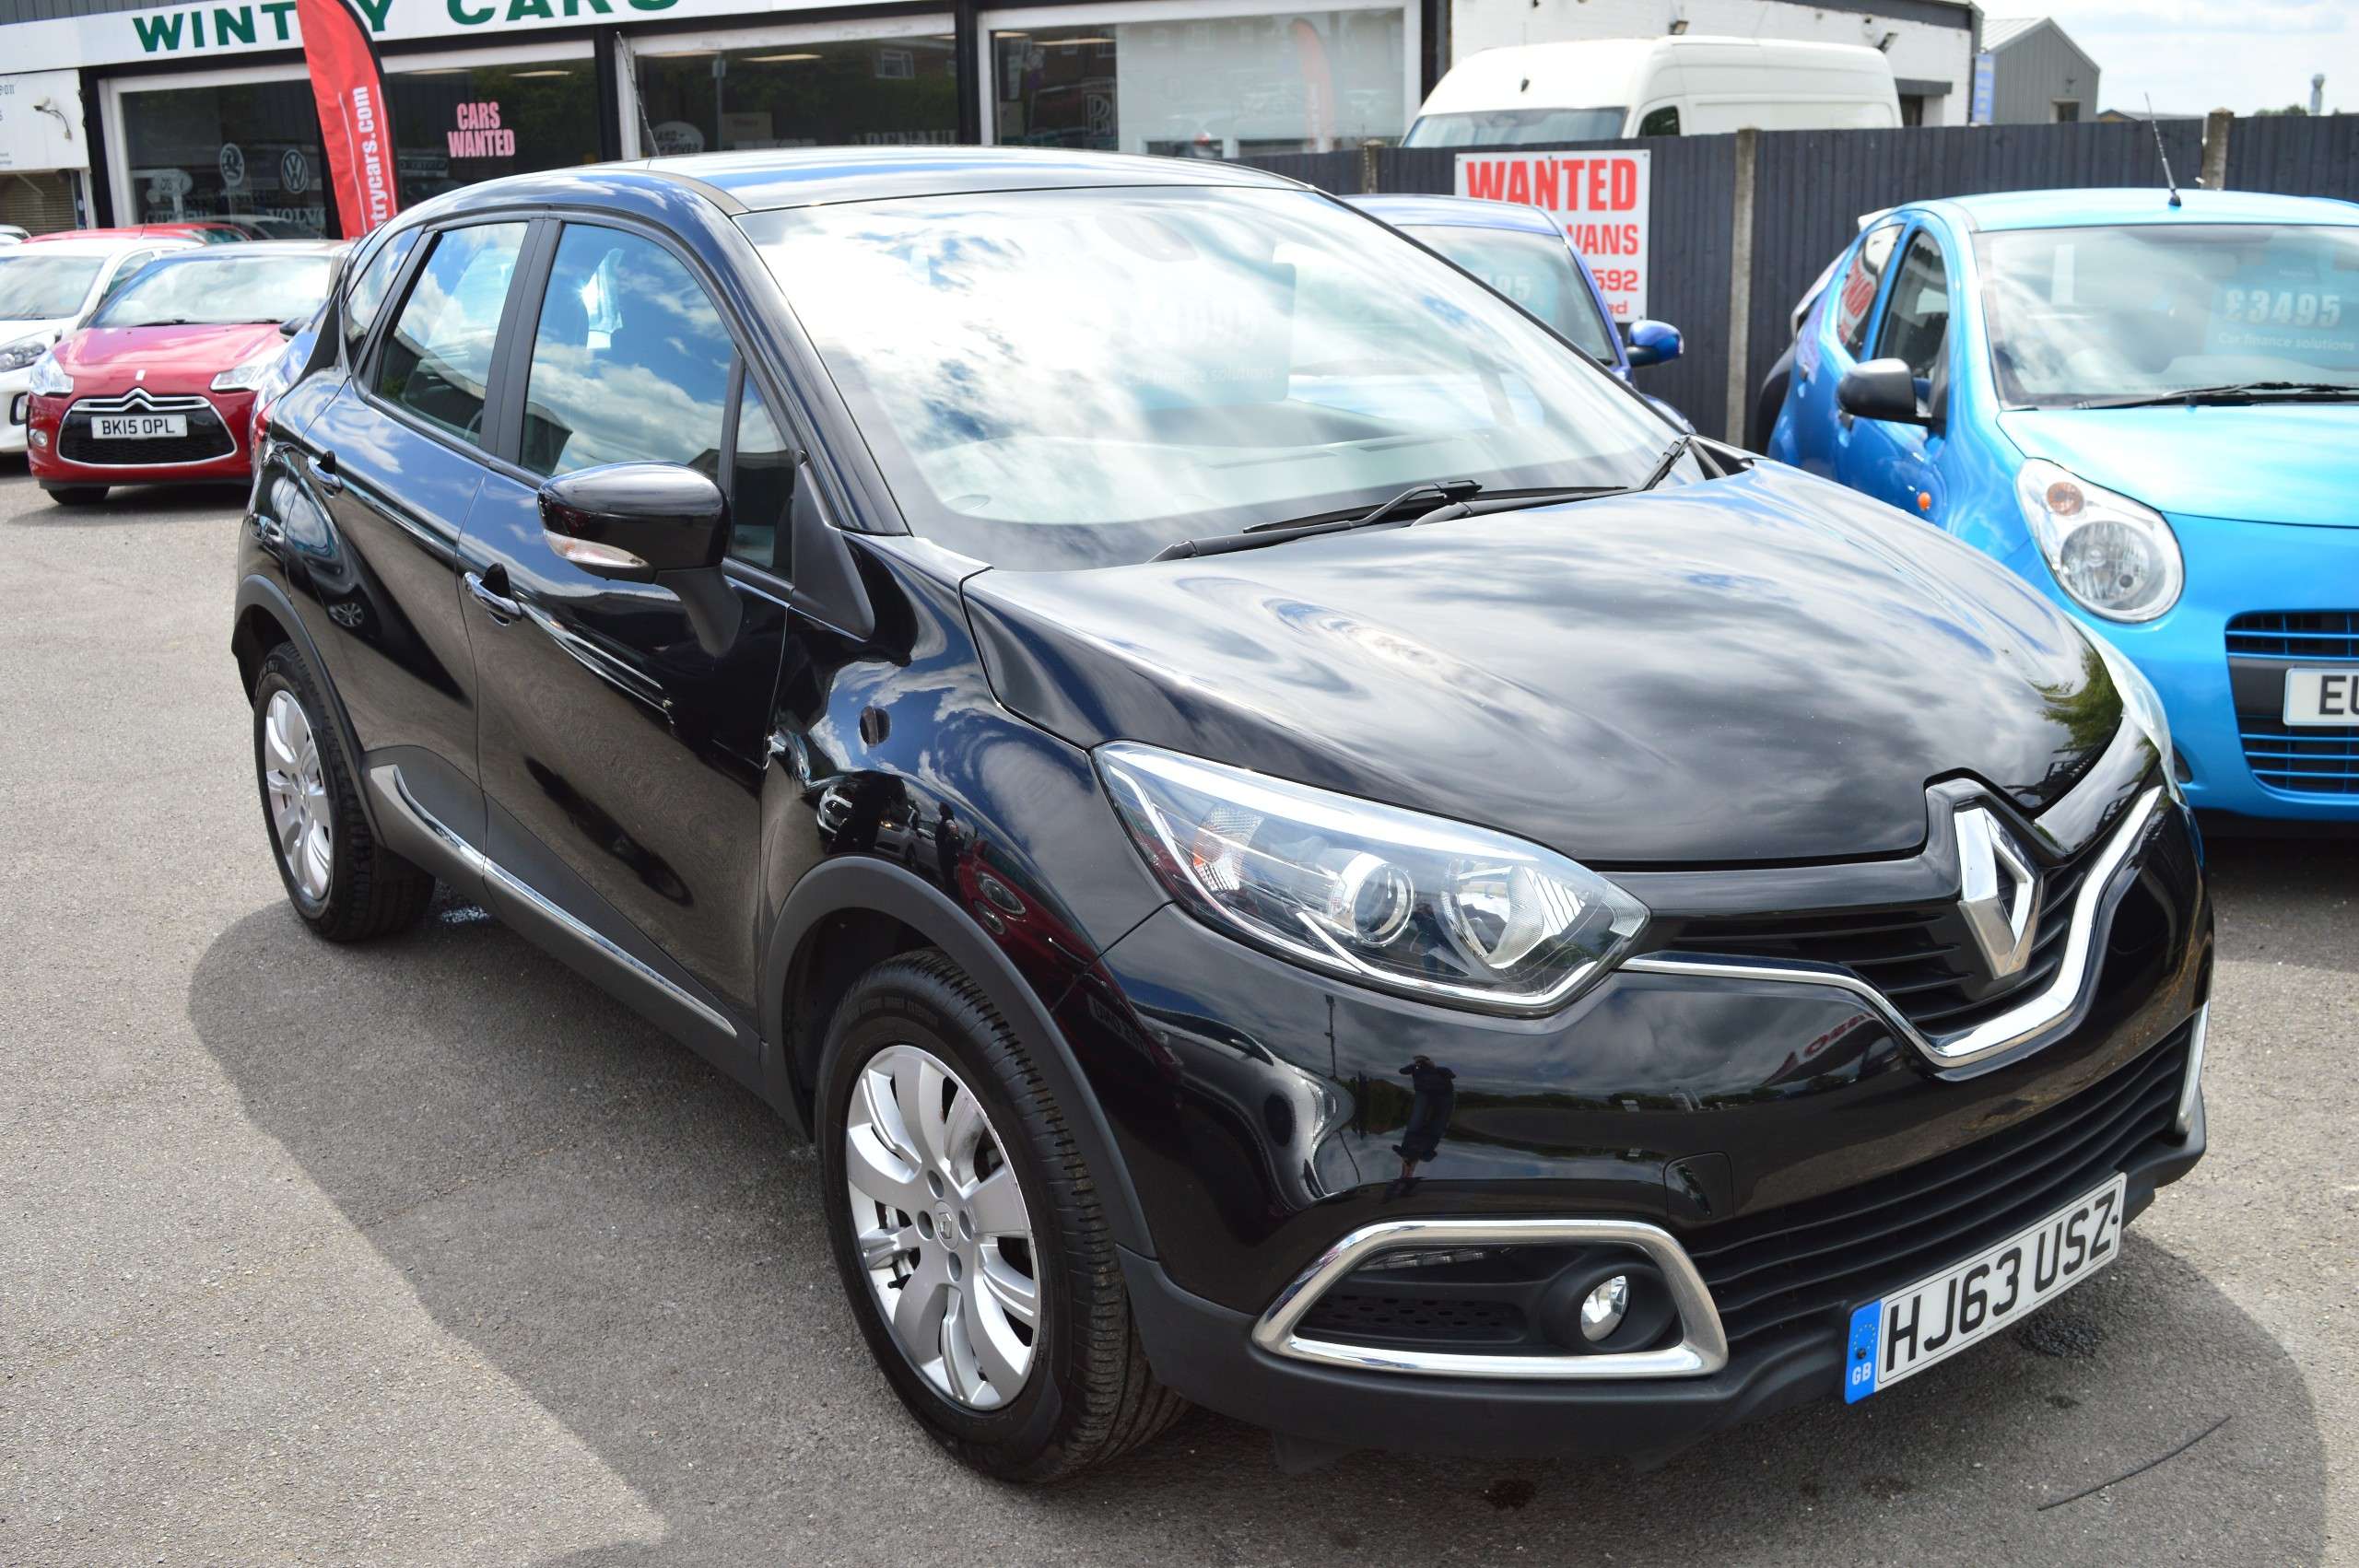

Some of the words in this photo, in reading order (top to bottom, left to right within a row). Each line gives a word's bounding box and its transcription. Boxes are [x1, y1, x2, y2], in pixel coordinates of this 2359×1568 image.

[132, 0, 393, 53] WINTY
[456, 101, 501, 131] CARS
[447, 129, 516, 158] WANTED
[1465, 158, 1638, 212] WANTED
[2225, 288, 2342, 327] £3495
[2294, 337, 2356, 352] solutions
[101, 419, 137, 435] BK15
[142, 418, 176, 434] OPL
[1885, 1246, 2022, 1373] HJ63
[2034, 1188, 2118, 1293] USZ
[1851, 1362, 1872, 1386] GB
